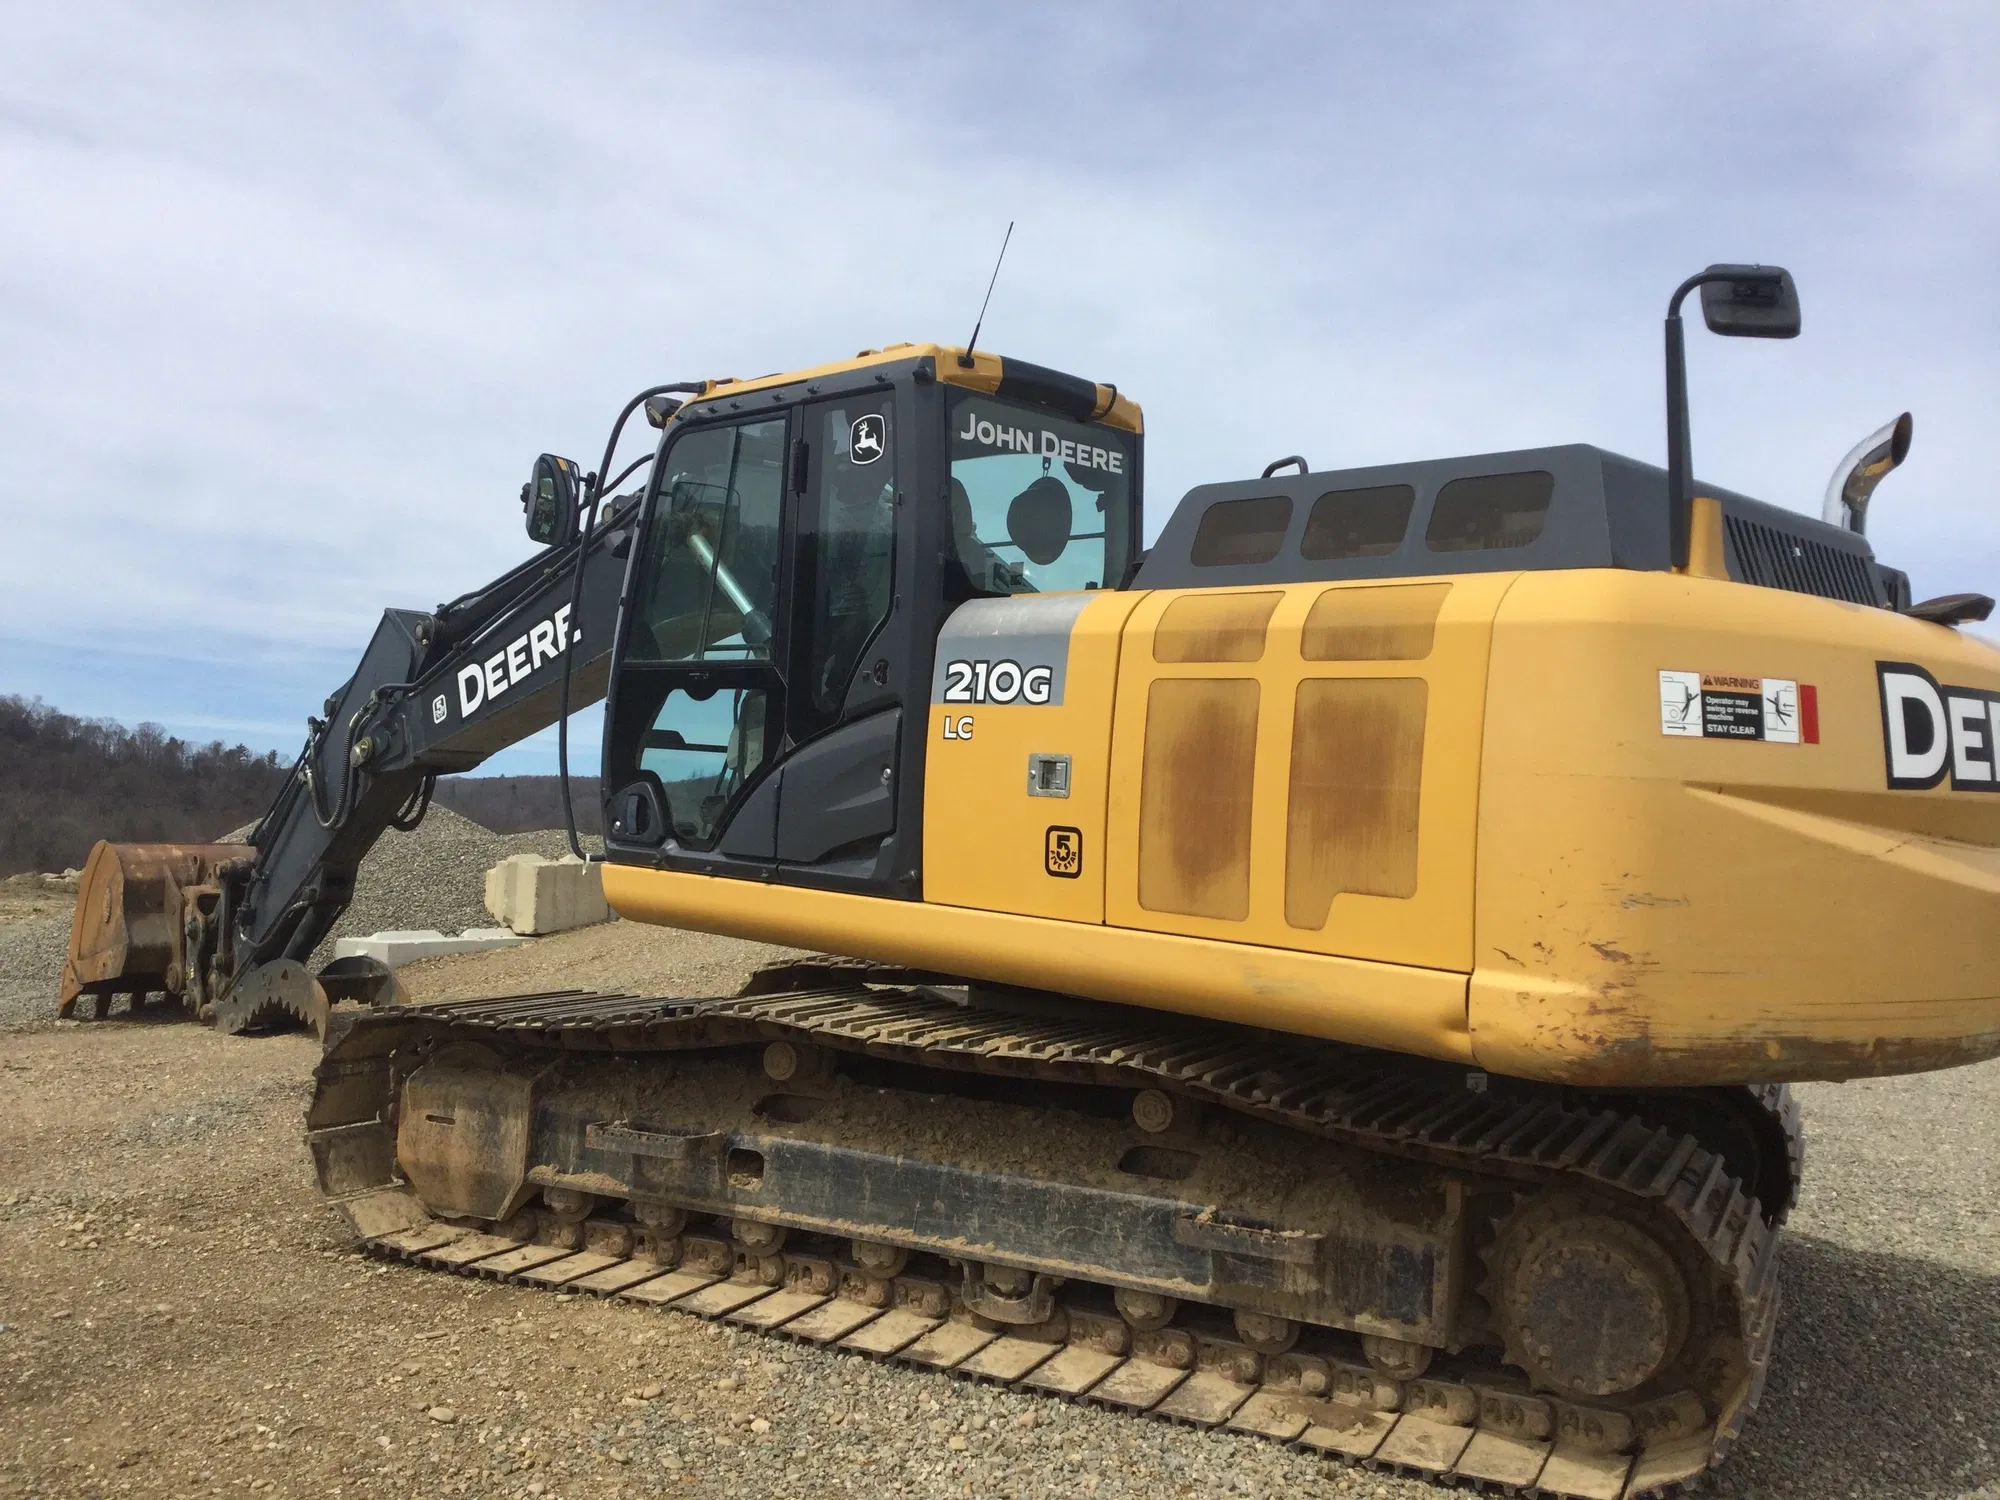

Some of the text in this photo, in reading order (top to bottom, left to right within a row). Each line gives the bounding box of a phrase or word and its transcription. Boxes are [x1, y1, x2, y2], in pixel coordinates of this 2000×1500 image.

[960, 413, 1123, 475] JOHN DEERE
[457, 602, 582, 719] DEERE
[944, 660, 1053, 704] 210G
[1713, 676, 1760, 690] WARNING
[1705, 696, 1749, 708] Operator may
[1706, 705, 1726, 714] swing
[943, 716, 974, 740] LC
[1706, 714, 1734, 722] machine
[1707, 724, 1756, 735] STAY CLEAR
[1056, 834, 1071, 862] 5
[1050, 850, 1077, 870] FIVE STAR
